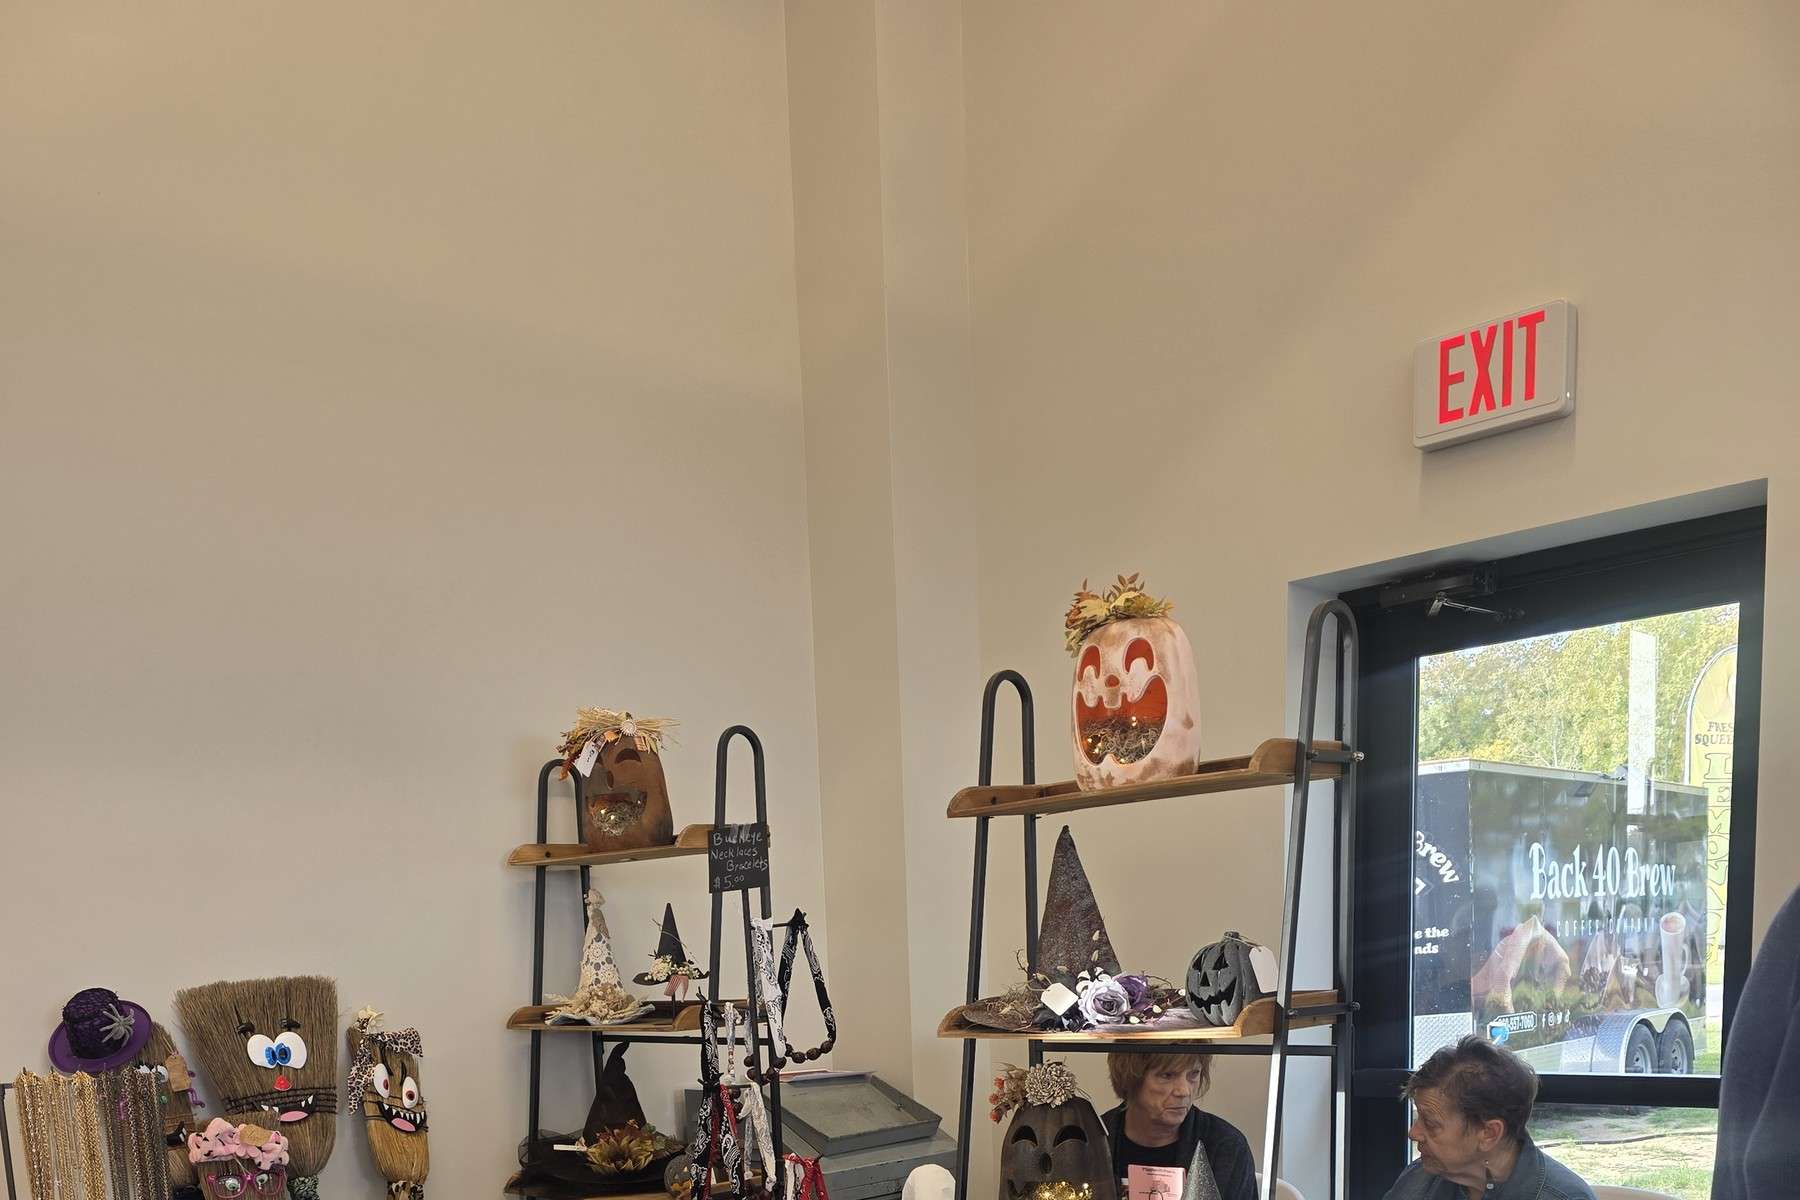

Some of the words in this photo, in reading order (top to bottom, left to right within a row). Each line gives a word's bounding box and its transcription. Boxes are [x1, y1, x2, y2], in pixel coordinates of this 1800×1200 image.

[1439, 311, 1545, 425] EXIT
[1707, 721, 1733, 733] FRES
[1695, 734, 1733, 747] SQUEE
[1529, 842, 1589, 900] Back
[1592, 843, 1620, 897] 40
[1623, 847, 1676, 899] Brew
[1424, 926, 1450, 939] the
